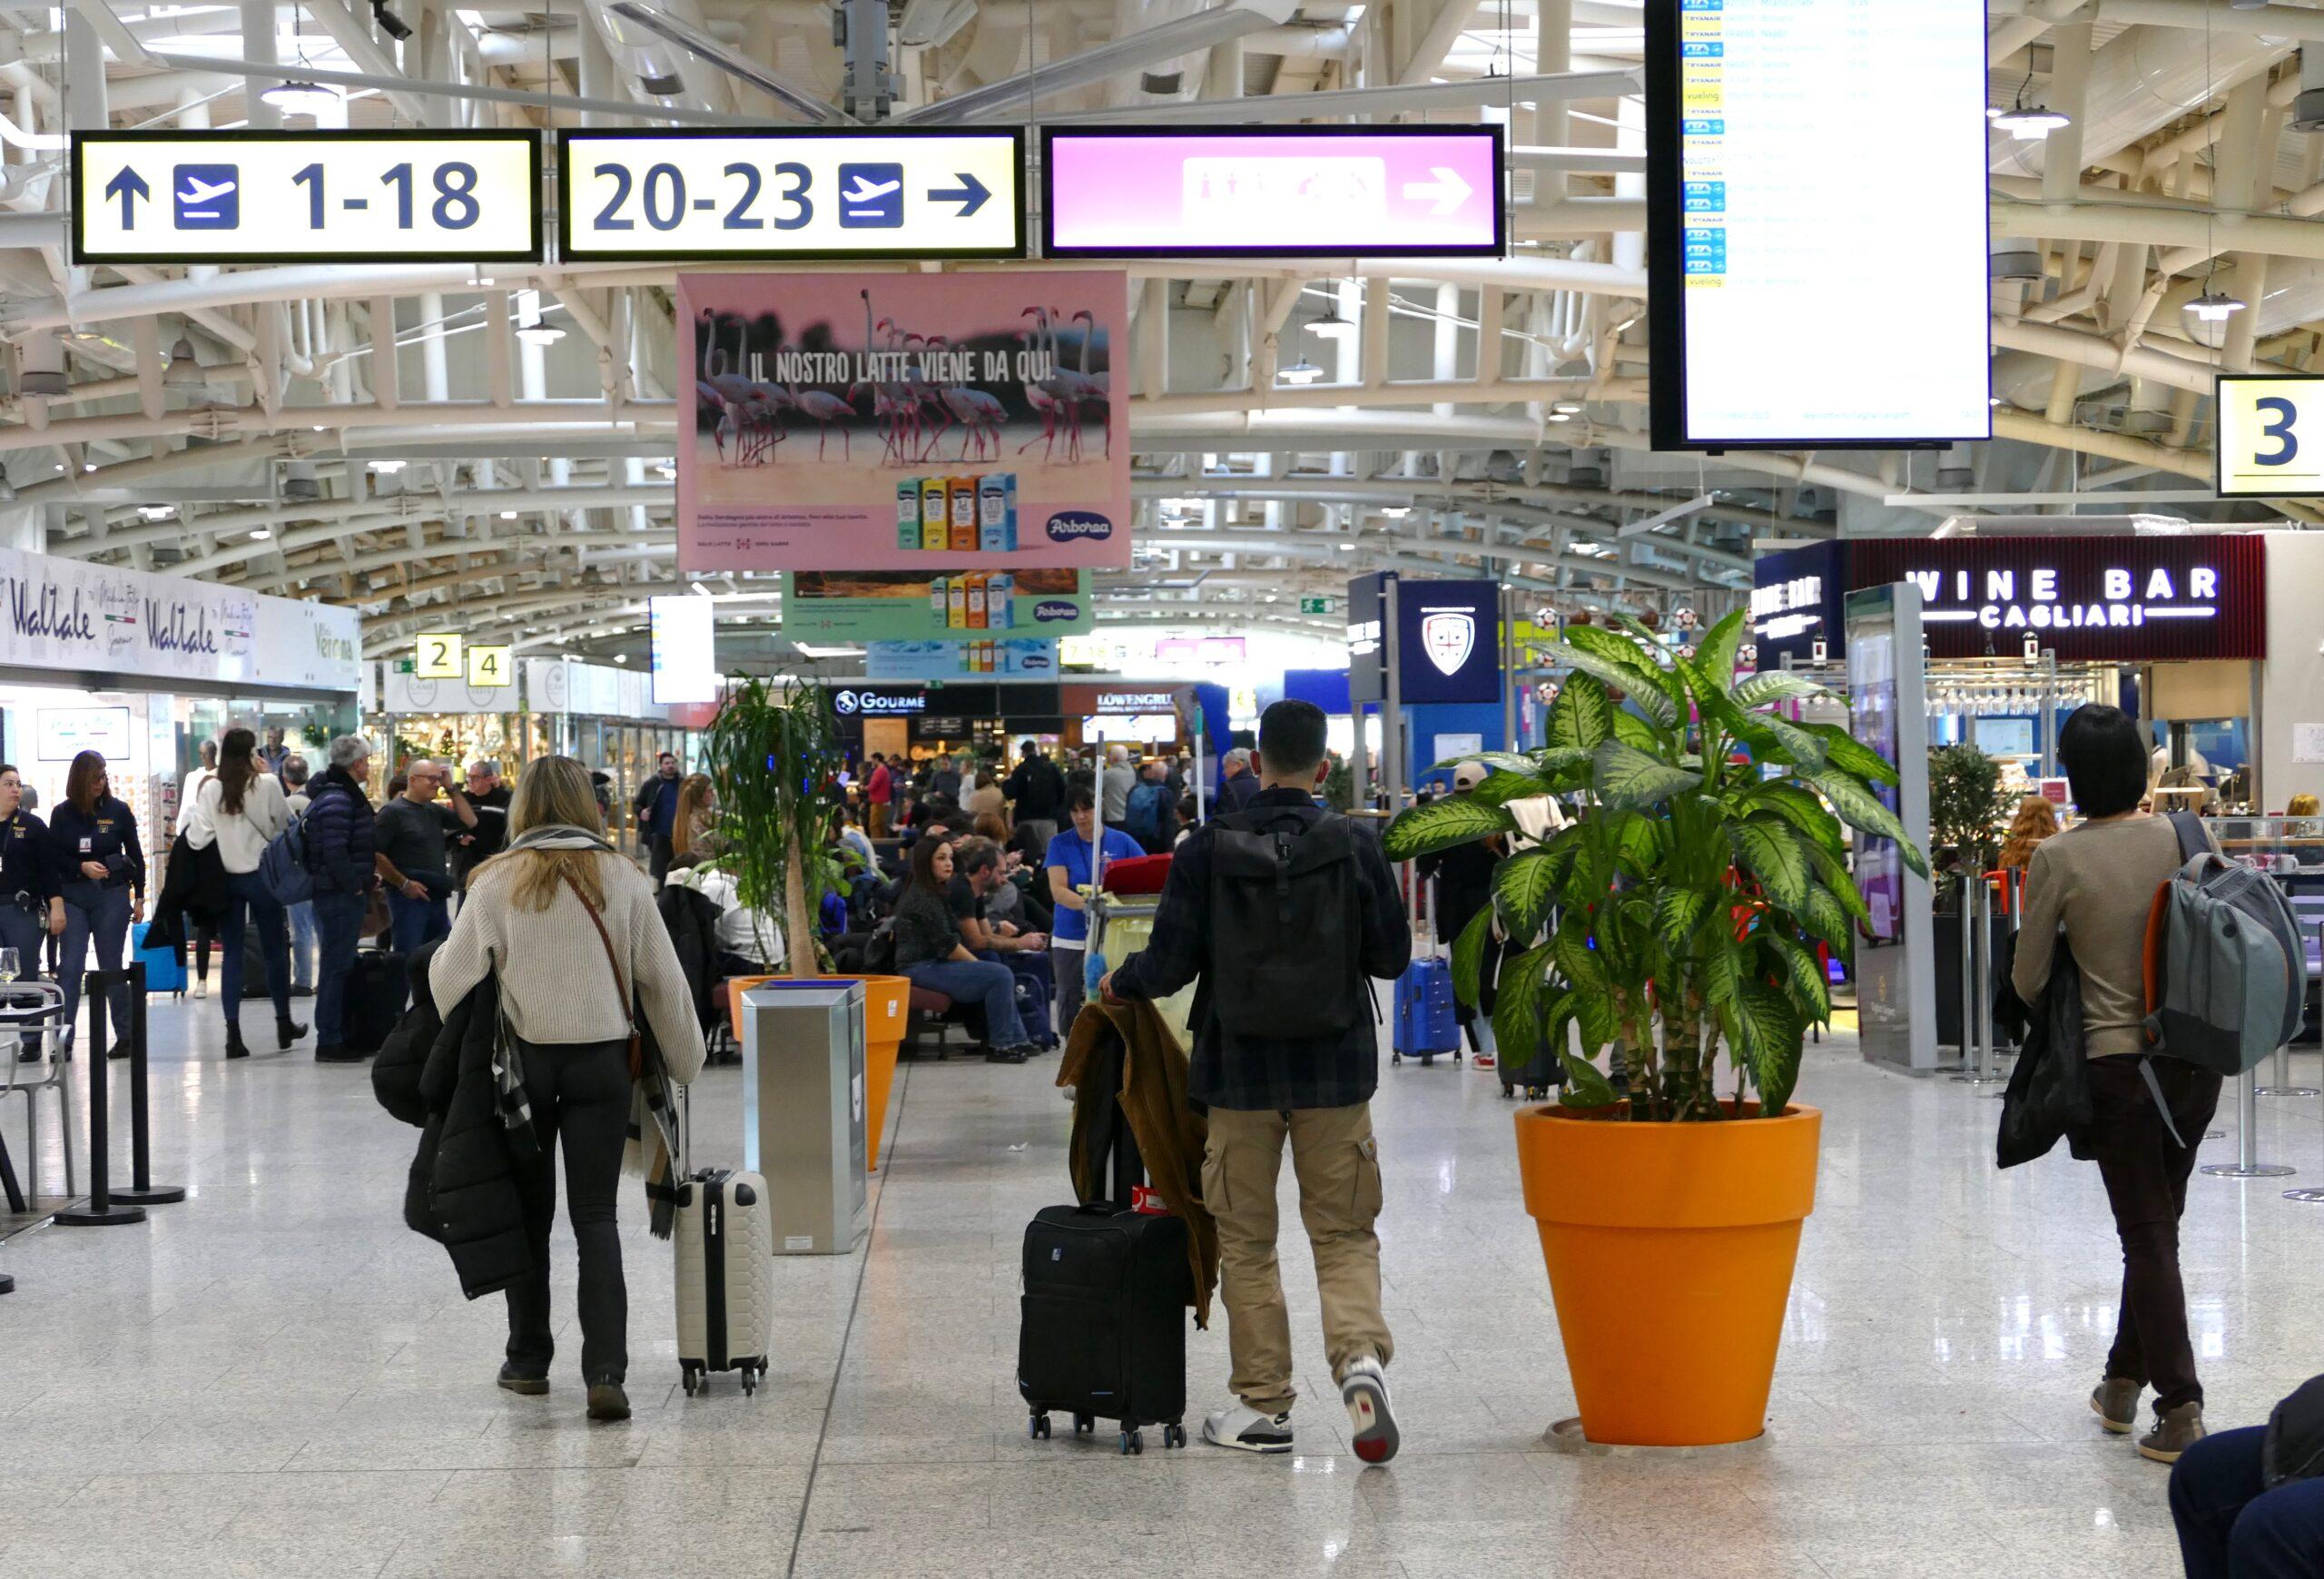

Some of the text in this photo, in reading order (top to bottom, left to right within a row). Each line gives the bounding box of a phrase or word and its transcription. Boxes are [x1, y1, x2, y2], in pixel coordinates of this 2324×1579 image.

[1687, 92, 1719, 102] vueling
[291, 162, 481, 231] 1-18
[593, 162, 814, 232] 20-23
[1689, 278, 1722, 288] vueling
[751, 350, 1057, 383] IL NOSTRO LATTE VIENE DA QUI.
[2254, 397, 2299, 467] 3
[1049, 518, 1110, 534] Arborea
[1905, 567, 2218, 602] WINE BAR
[1979, 604, 2143, 628] CAGLIARI
[431, 642, 448, 666] 2
[481, 654, 497, 676] 4
[1097, 693, 1175, 706] LÖWENGRU
